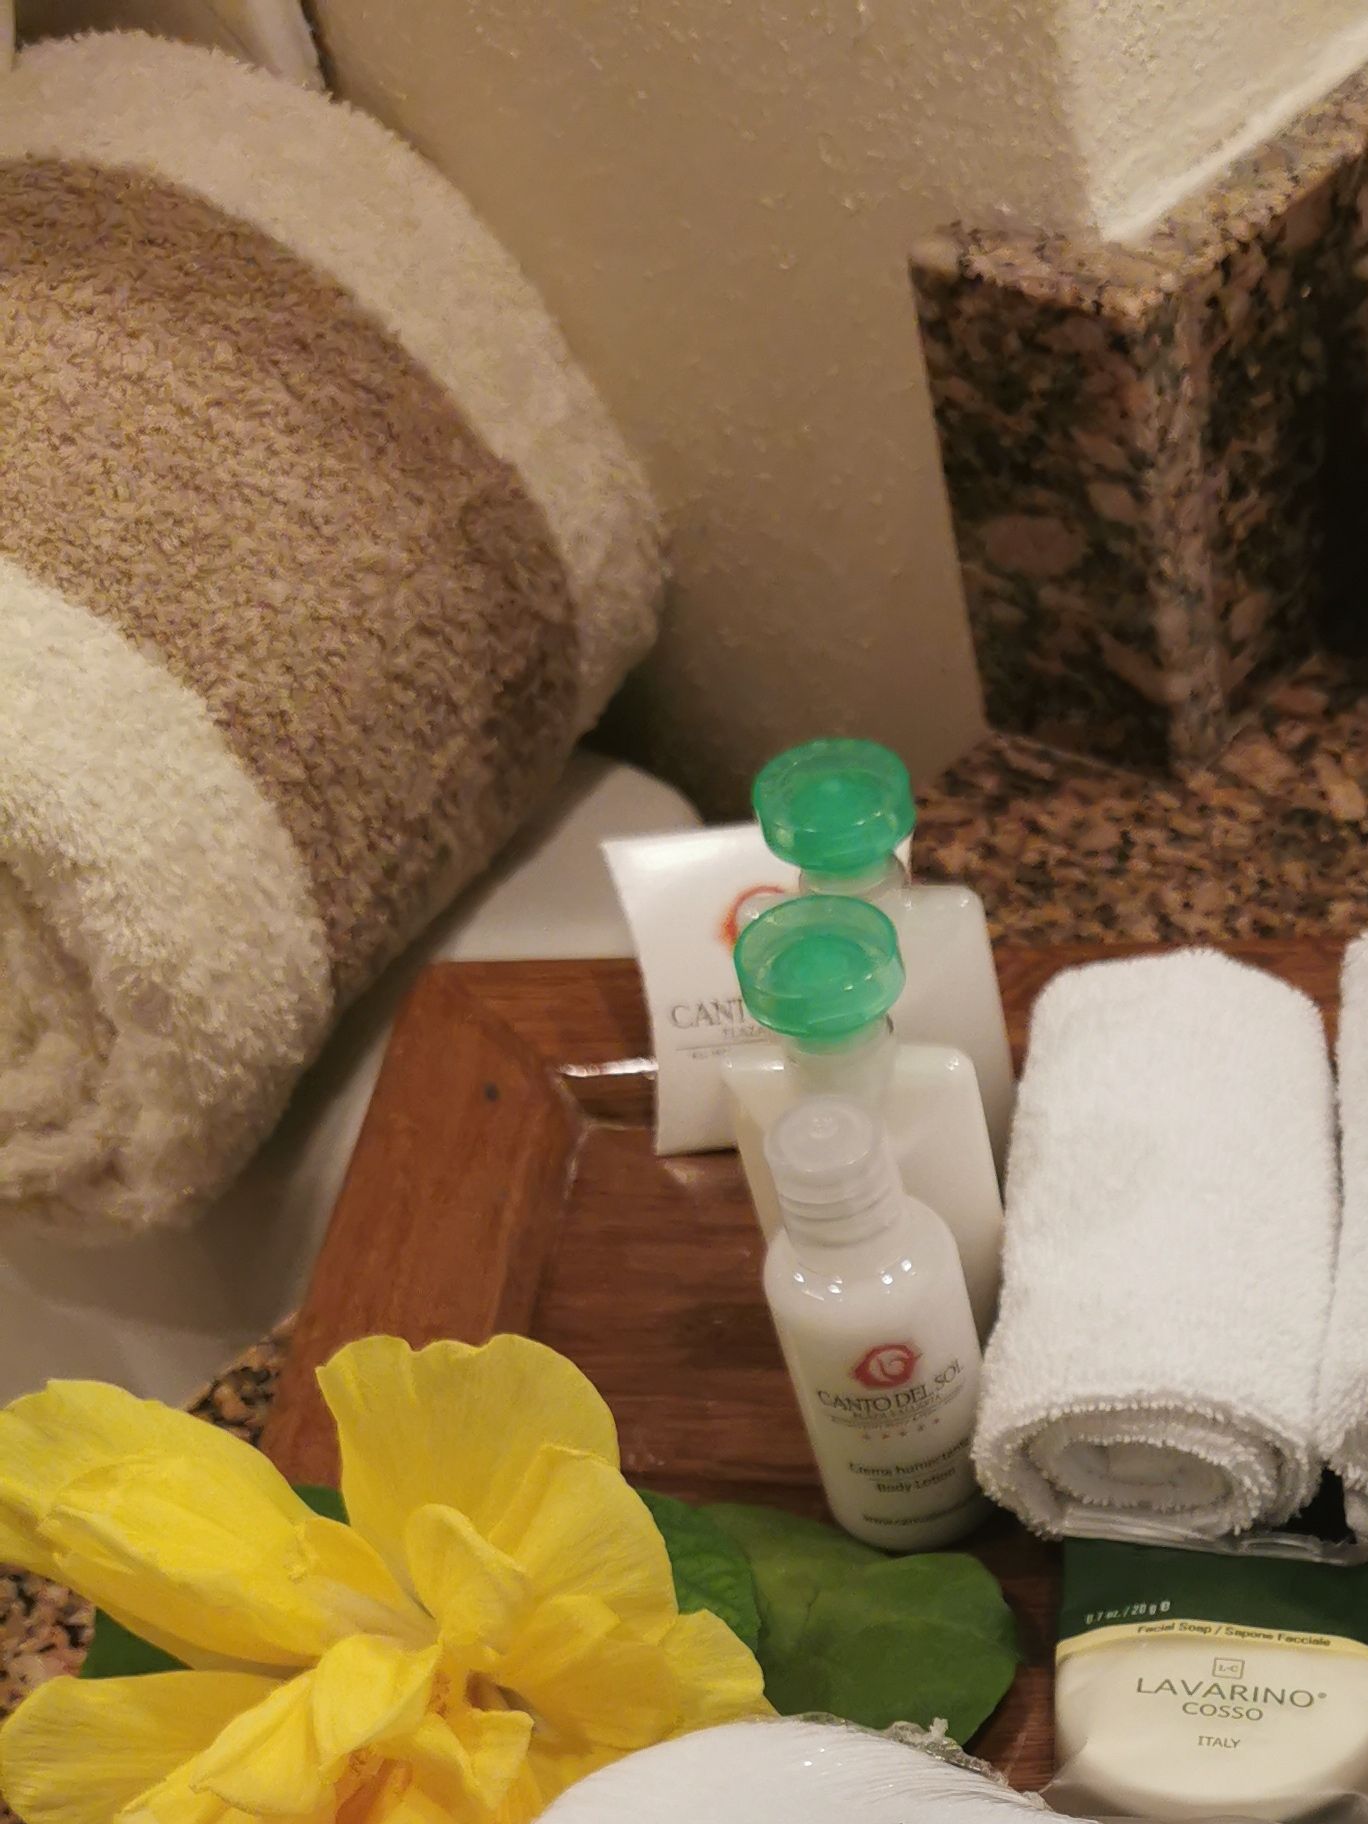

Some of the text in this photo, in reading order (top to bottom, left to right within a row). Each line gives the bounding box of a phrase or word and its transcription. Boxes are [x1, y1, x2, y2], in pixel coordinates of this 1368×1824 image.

[671, 998, 745, 1031] CANT
[815, 1358, 964, 1414] CANTO DEL SOL
[875, 1466, 956, 1494] Body Lotion
[1137, 1622, 1175, 1634] Facial
[1179, 1622, 1212, 1635] Soap
[1224, 1626, 1275, 1641] Sapone
[1277, 1633, 1332, 1647] Facciale
[1182, 1701, 1263, 1722] COSSO
[1197, 1735, 1241, 1750] ITALY
